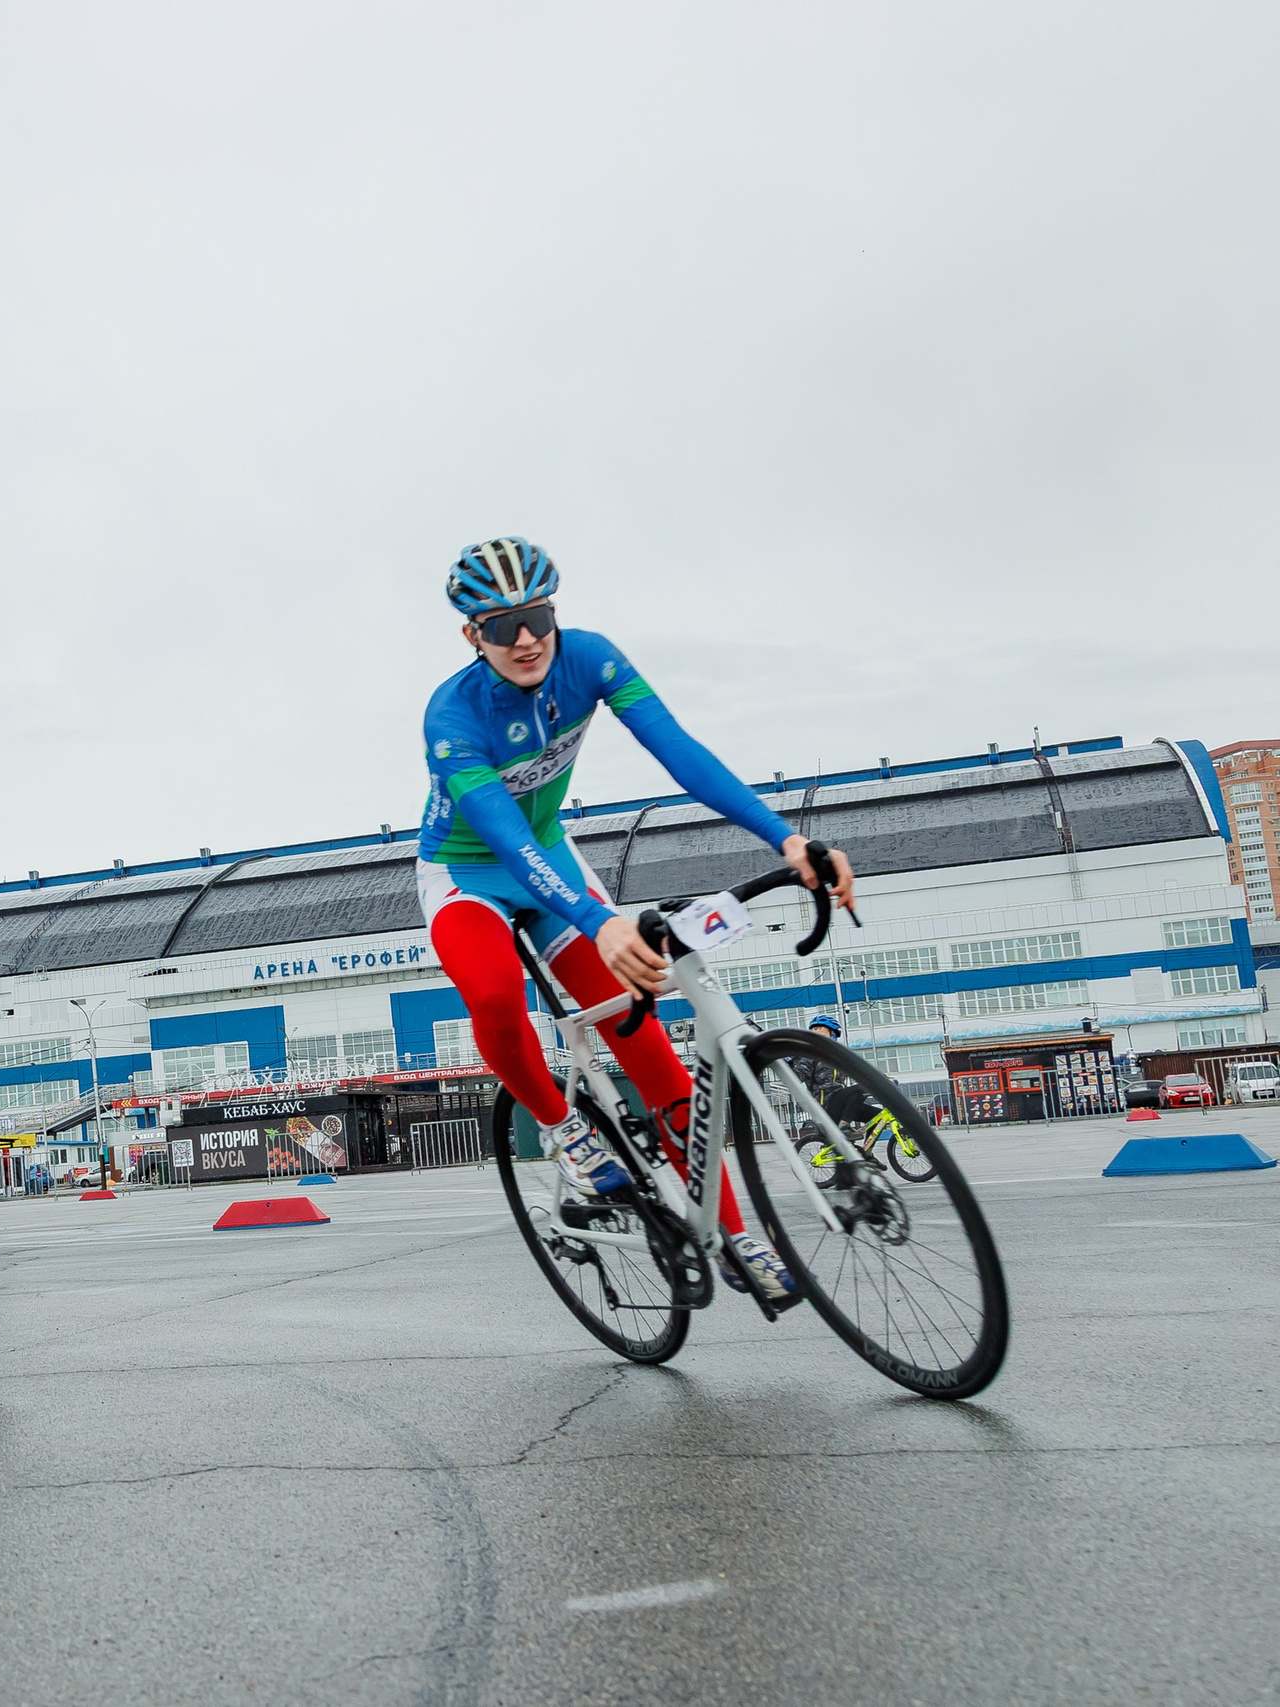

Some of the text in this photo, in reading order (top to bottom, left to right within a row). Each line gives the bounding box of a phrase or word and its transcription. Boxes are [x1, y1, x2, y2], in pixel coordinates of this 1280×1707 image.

[703, 910, 728, 937] 4
[253, 945, 426, 980] АРЕНА "ЕРОФЕЙ"
[301, 1079, 341, 1091] ЮЖНЫЙ
[393, 1067, 484, 1081] ВХОД ЦЕНТРАЛЬНЫЙ
[138, 1097, 160, 1105] ВХОД
[223, 1100, 307, 1119] КЕБАБ-ХАУС
[200, 1128, 259, 1151] ИСТОРИЯ
[687, 1057, 713, 1208] Bianchi
[202, 1149, 246, 1170] ВКУСА
[863, 1339, 959, 1388] VELOMANN
